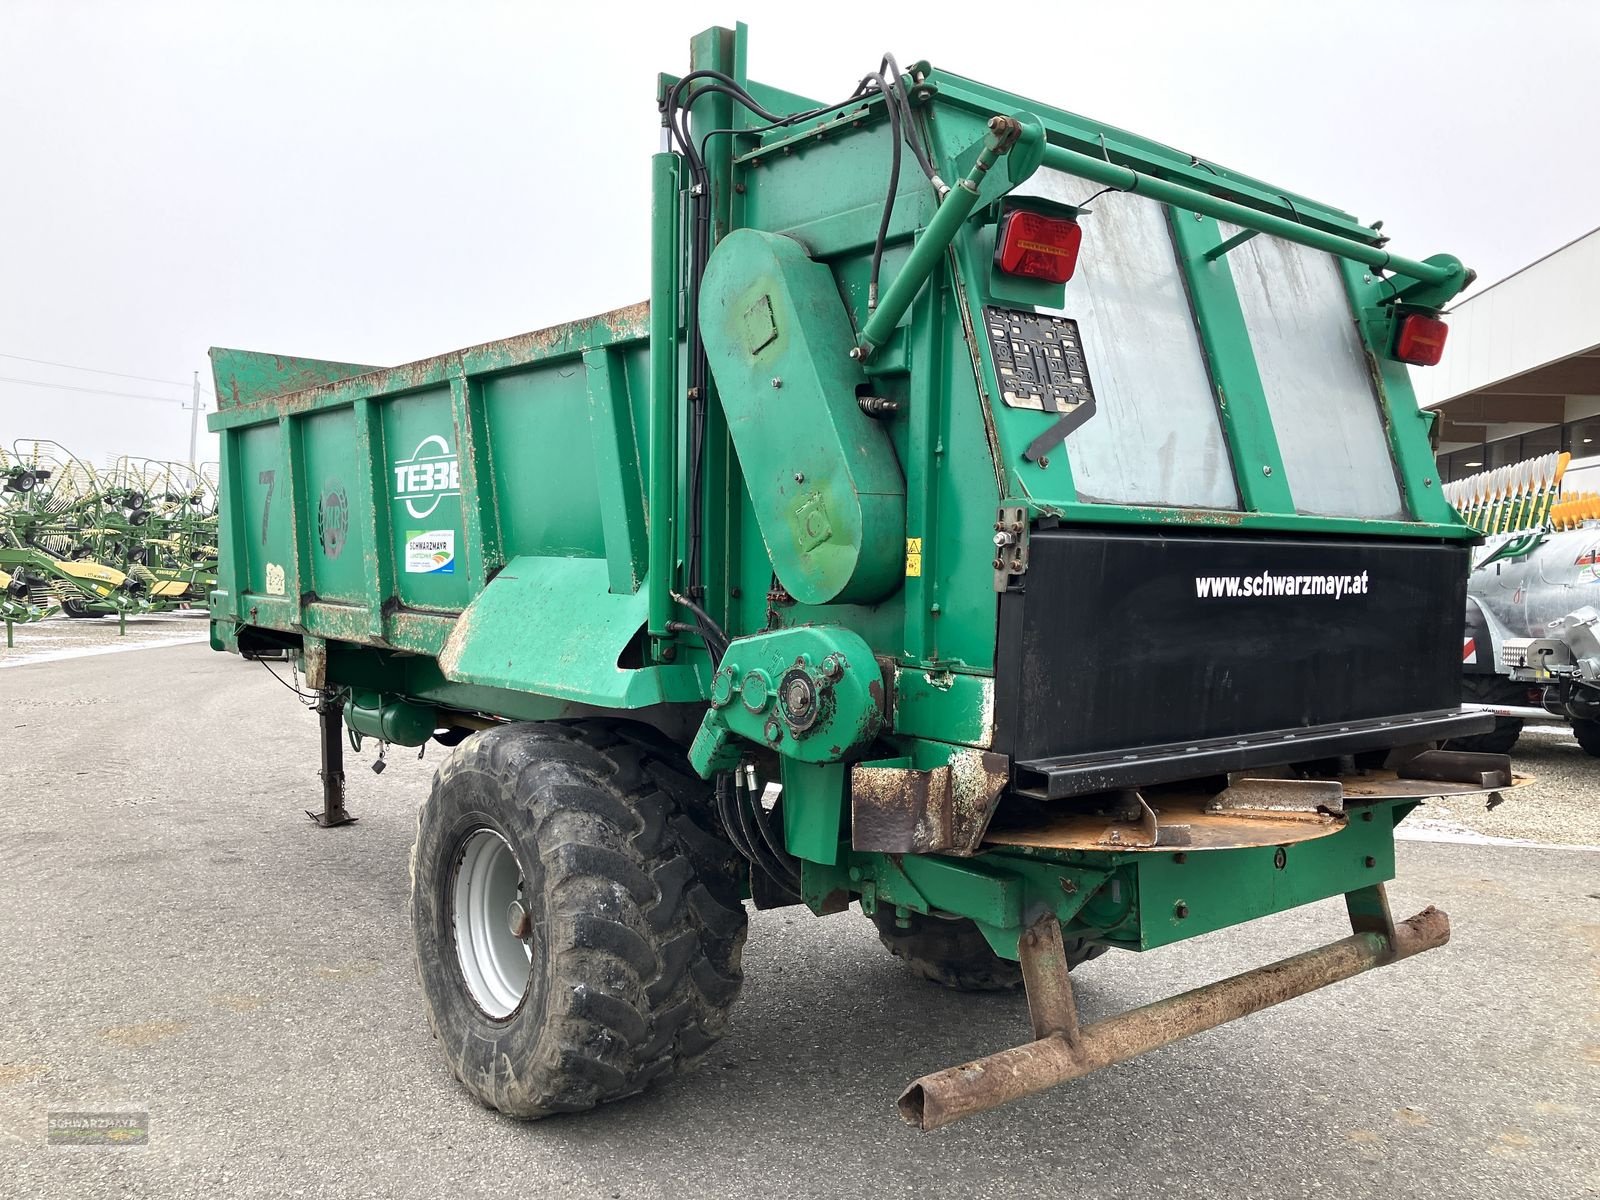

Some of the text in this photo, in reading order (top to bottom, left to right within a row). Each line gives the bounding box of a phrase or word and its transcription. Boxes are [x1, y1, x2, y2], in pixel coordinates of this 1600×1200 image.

[394, 461, 460, 493] TEBBE
[259, 470, 275, 546] 7
[409, 541, 448, 551] SCHWARZMAYR
[1195, 569, 1369, 600] www.schwarzmayr.at
